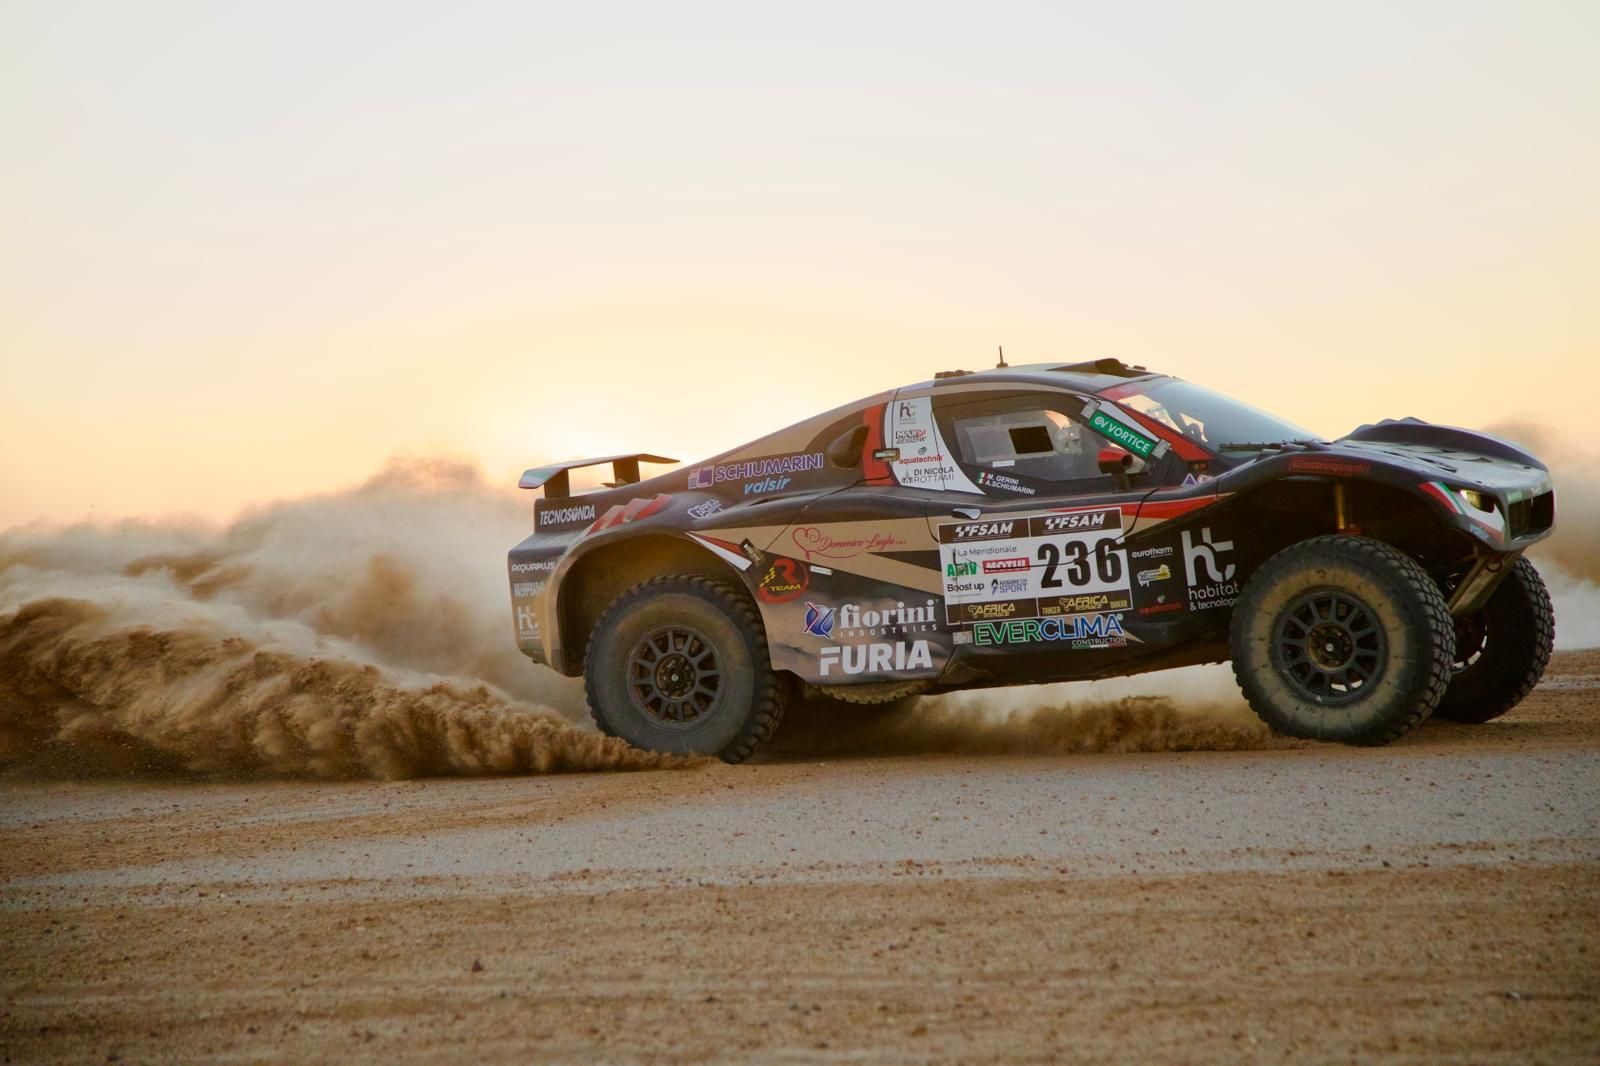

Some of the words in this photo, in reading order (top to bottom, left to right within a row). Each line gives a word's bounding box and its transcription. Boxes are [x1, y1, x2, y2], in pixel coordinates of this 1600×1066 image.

[1108, 423, 1151, 453] VORTICE
[899, 454, 944, 465] aquatechnik
[715, 453, 823, 482] SCHIUMARINI
[924, 466, 954, 476] NICOLA
[744, 475, 791, 495] valsir
[914, 474, 954, 484] ROTTAMI
[995, 475, 1020, 486] GERINI
[540, 504, 595, 526] TECNOSONDA
[1132, 546, 1173, 558] eurotherm
[1037, 537, 1122, 589] 236
[947, 583, 973, 592] Boost
[974, 582, 985, 592] up
[1000, 584, 1028, 593] SPORT
[1188, 581, 1240, 600] habitat
[1066, 595, 1109, 608] AFRICA
[1189, 601, 1197, 611] &
[839, 599, 937, 629] fiorini
[975, 603, 1016, 614] AFRICA
[840, 624, 938, 638] INDUSTRIES
[973, 613, 1123, 646] EVERCLIMA
[1071, 637, 1127, 646] CONSTRUCTION
[820, 640, 933, 676] FURIA
